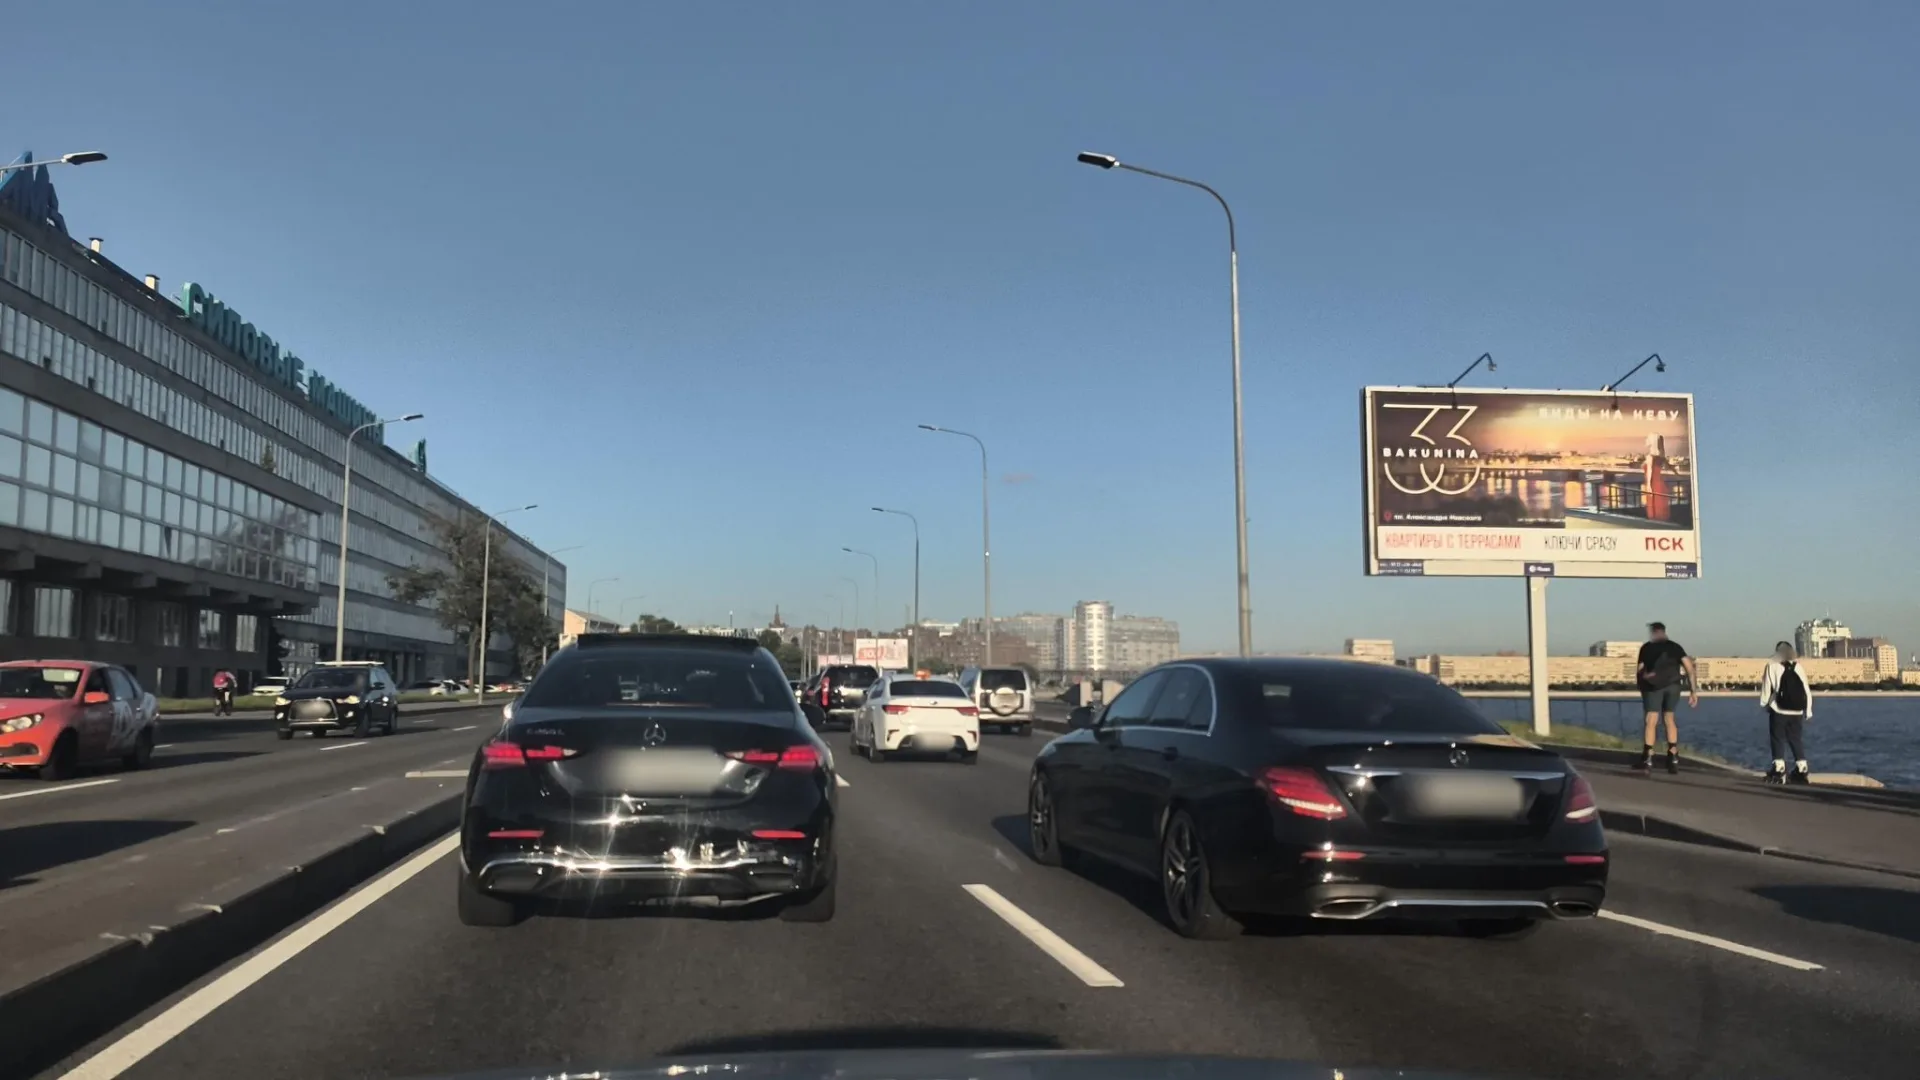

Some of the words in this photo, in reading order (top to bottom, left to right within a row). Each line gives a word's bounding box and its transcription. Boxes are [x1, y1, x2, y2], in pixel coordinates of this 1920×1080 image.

[1538, 408, 1591, 420] ВИДЫ
[1600, 408, 1623, 421] НА
[1633, 409, 1679, 422] НЕВУ
[1382, 447, 1479, 459] BAKUNINA
[1406, 513, 1448, 522] Александра
[1449, 514, 1483, 522] Невского
[1385, 532, 1443, 549] КВАРТИРЫ
[1446, 533, 1454, 549] С
[1458, 533, 1522, 550] ТЕРРАСАМИ
[1544, 535, 1582, 551] КЛЮЧИ
[1586, 536, 1618, 551] СРАЗУ
[1645, 537, 1684, 551] ПСК
